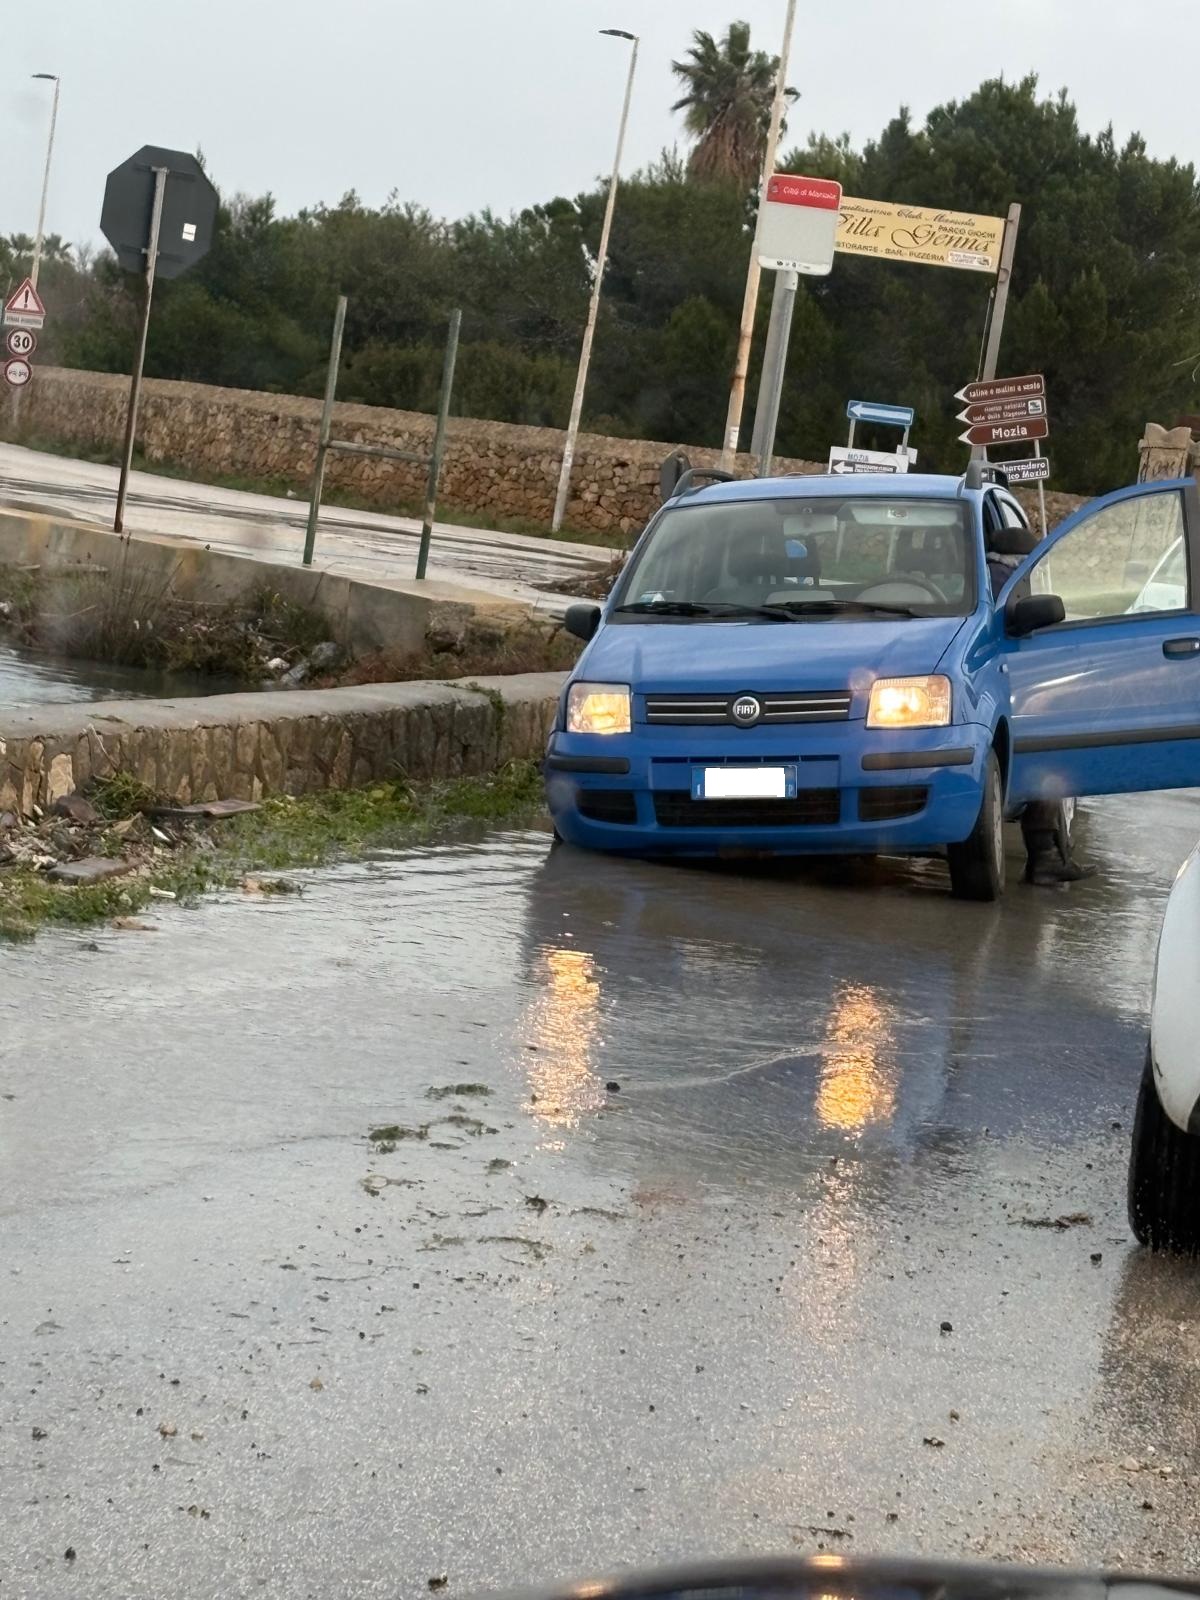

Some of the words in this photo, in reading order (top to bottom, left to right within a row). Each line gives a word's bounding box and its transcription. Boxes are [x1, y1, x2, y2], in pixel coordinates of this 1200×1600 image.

[938, 225, 966, 235] PARCO
[967, 229, 996, 239] GIOCHI
[908, 251, 945, 262] PIZZERIA
[13, 335, 30, 349] 30
[991, 425, 1028, 439] Mozia
[1002, 461, 1046, 472] barcadero
[1022, 469, 1047, 478] Mozia
[736, 705, 756, 715] FIAT
